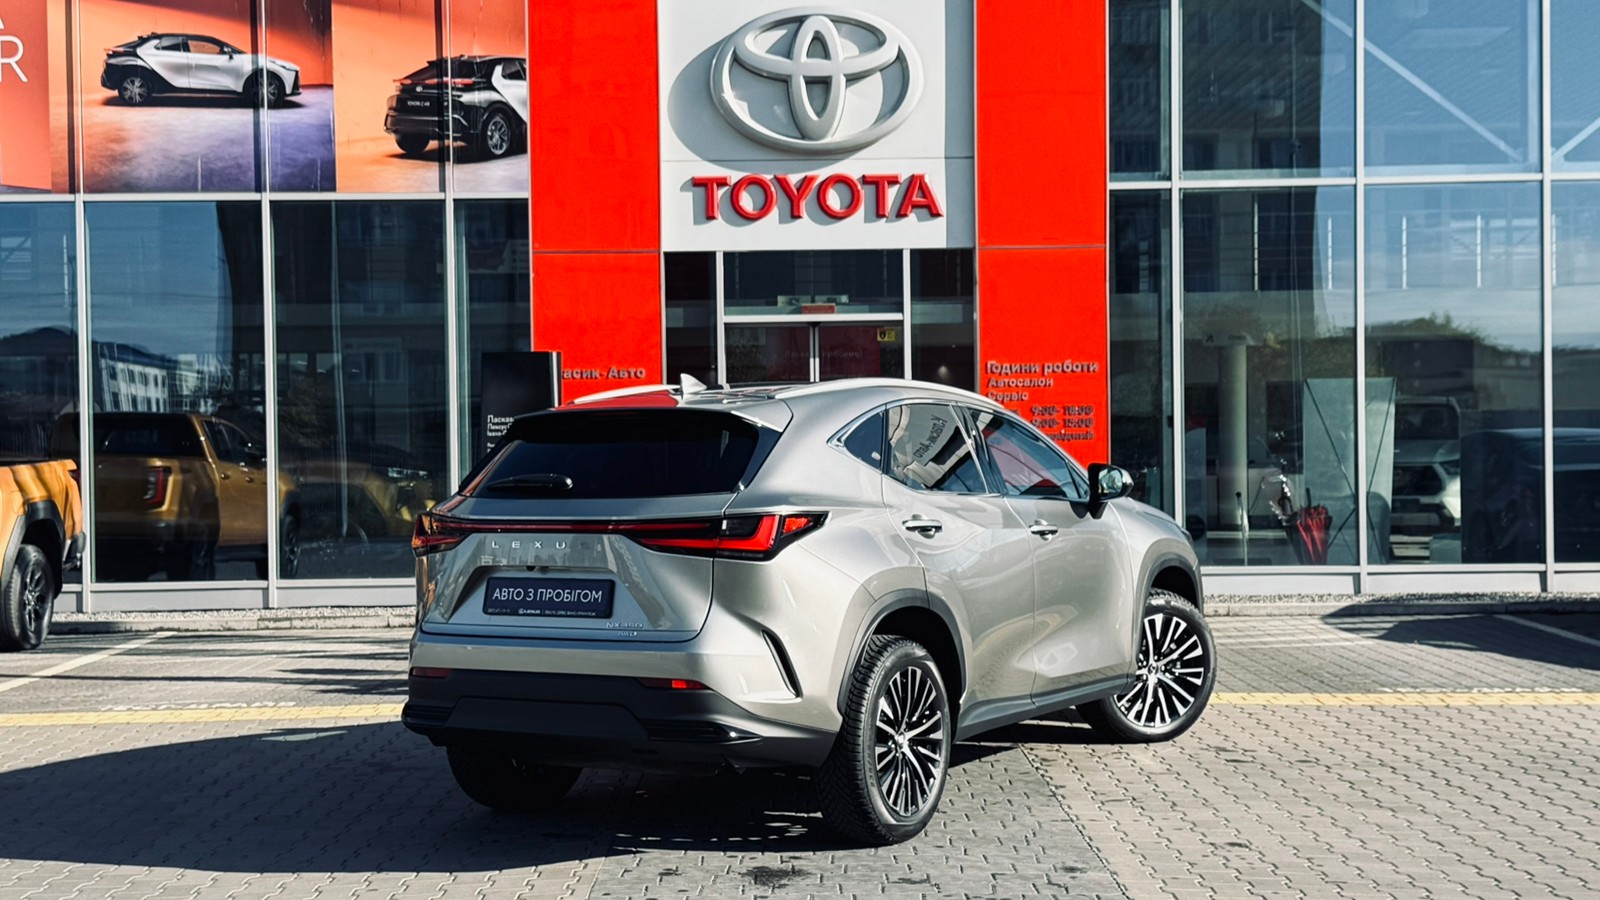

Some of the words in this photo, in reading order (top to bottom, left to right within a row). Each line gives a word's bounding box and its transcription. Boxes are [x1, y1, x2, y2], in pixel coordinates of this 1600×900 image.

[0, 35, 28, 82] R
[691, 173, 944, 221] TOYOTA
[561, 366, 646, 379] асик-Авто
[987, 360, 1039, 375] Години
[1044, 359, 1099, 376] роботи
[988, 377, 1054, 388] Автосалон
[987, 391, 1029, 403] Сервіс
[492, 588, 524, 601] АВТО
[536, 588, 603, 603] ПРОБІГОМ
